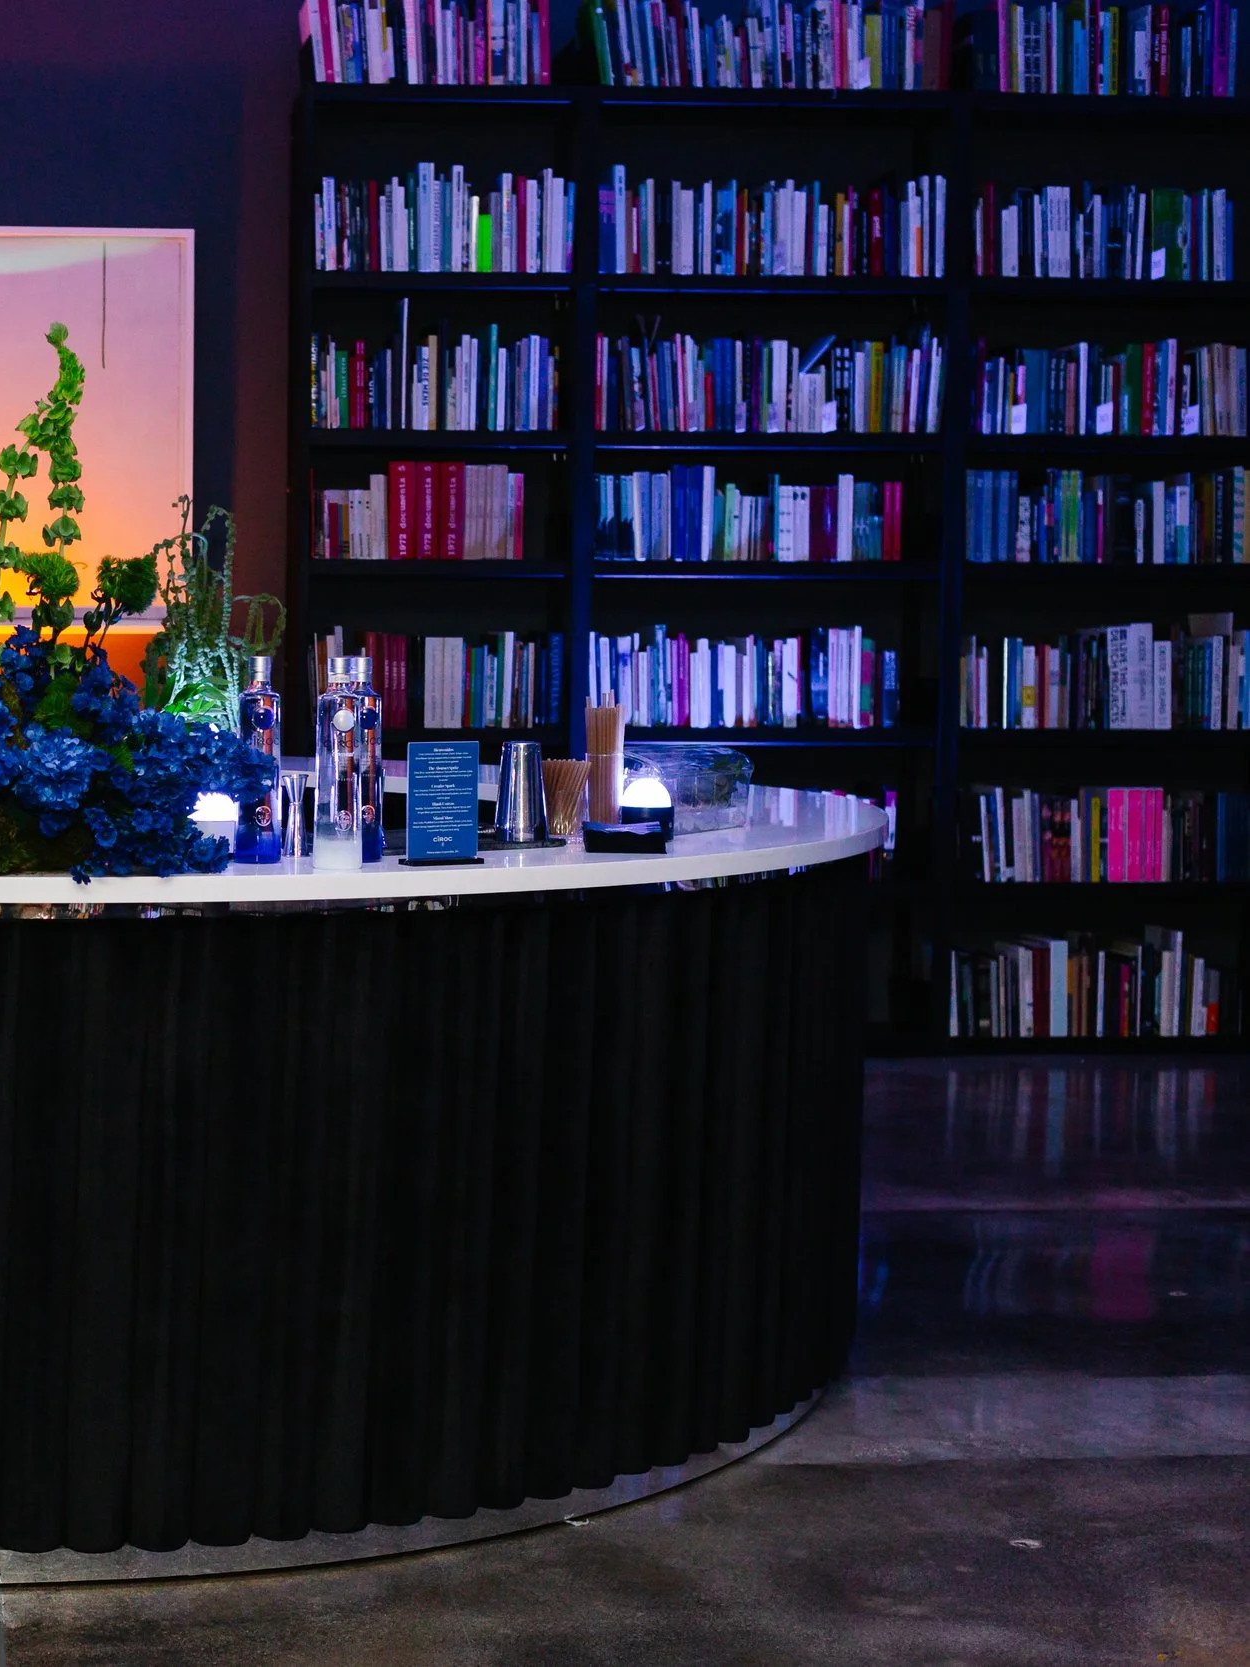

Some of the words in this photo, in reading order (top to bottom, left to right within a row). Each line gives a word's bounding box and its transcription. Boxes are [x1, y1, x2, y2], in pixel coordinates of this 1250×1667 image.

[398, 477, 407, 529] documenta
[424, 477, 432, 529] documenta
[448, 477, 456, 529] documenta
[398, 533, 407, 556] 1972
[424, 533, 432, 556] 1972
[448, 533, 456, 556] 1972
[549, 634, 560, 707] ACQUAVELLA
[1110, 671, 1119, 724] PROJECTS
